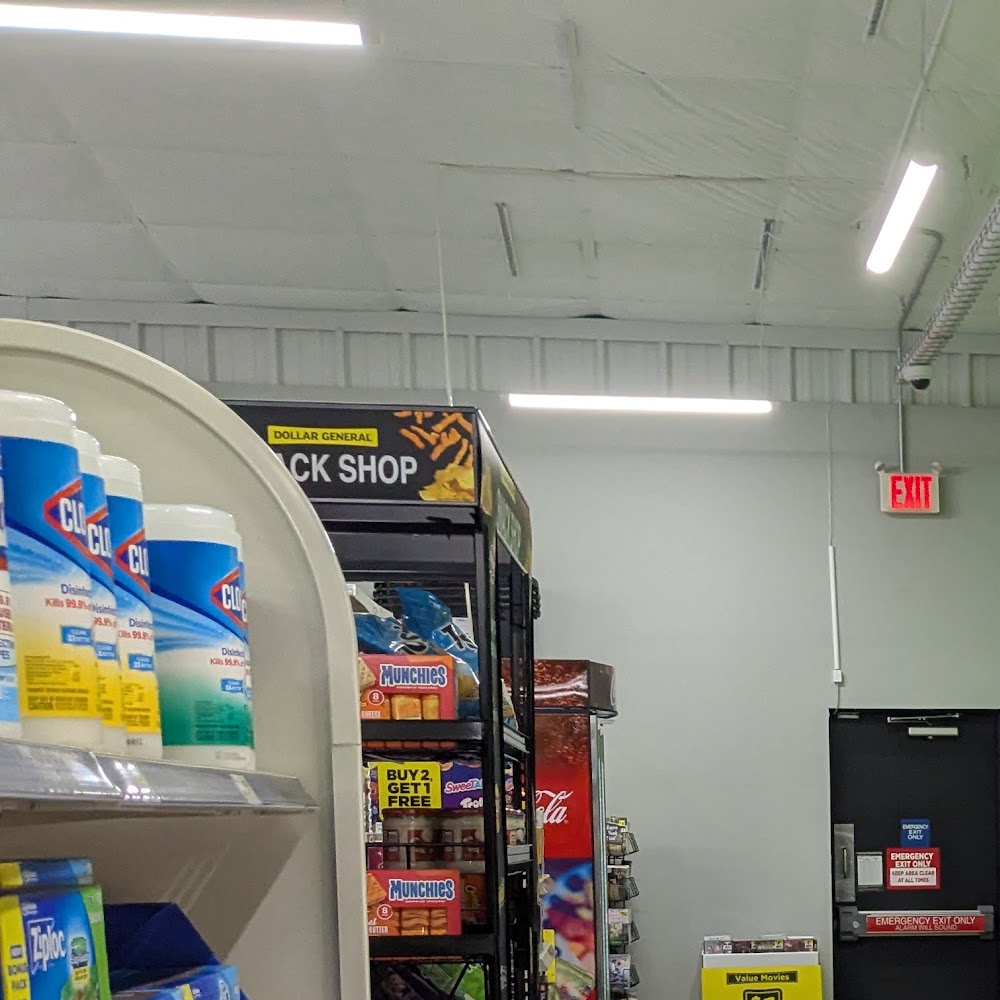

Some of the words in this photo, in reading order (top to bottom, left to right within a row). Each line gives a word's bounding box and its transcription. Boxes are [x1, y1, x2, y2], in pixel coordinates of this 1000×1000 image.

[274, 430, 318, 441] DOLLAR
[321, 432, 373, 442] GENERAL
[338, 454, 418, 485] SHOP
[889, 474, 932, 510] EXIT
[380, 664, 448, 688] MUNCHIES
[387, 769, 419, 781] BUY
[421, 769, 433, 782] 2,
[388, 782, 421, 794] GET
[424, 782, 431, 794] 1
[388, 795, 431, 807] FREE
[890, 852, 934, 860] EMERGENCY
[895, 860, 911, 868] EXIT
[912, 860, 932, 868] ONLY
[388, 879, 455, 902] MUNCHIES
[875, 916, 931, 926] EMERGENCY
[932, 916, 953, 925] EXIT
[953, 916, 976, 925] ONLY
[30, 925, 66, 974] Ziploc
[734, 974, 759, 982] Value
[760, 973, 790, 981] Movies
